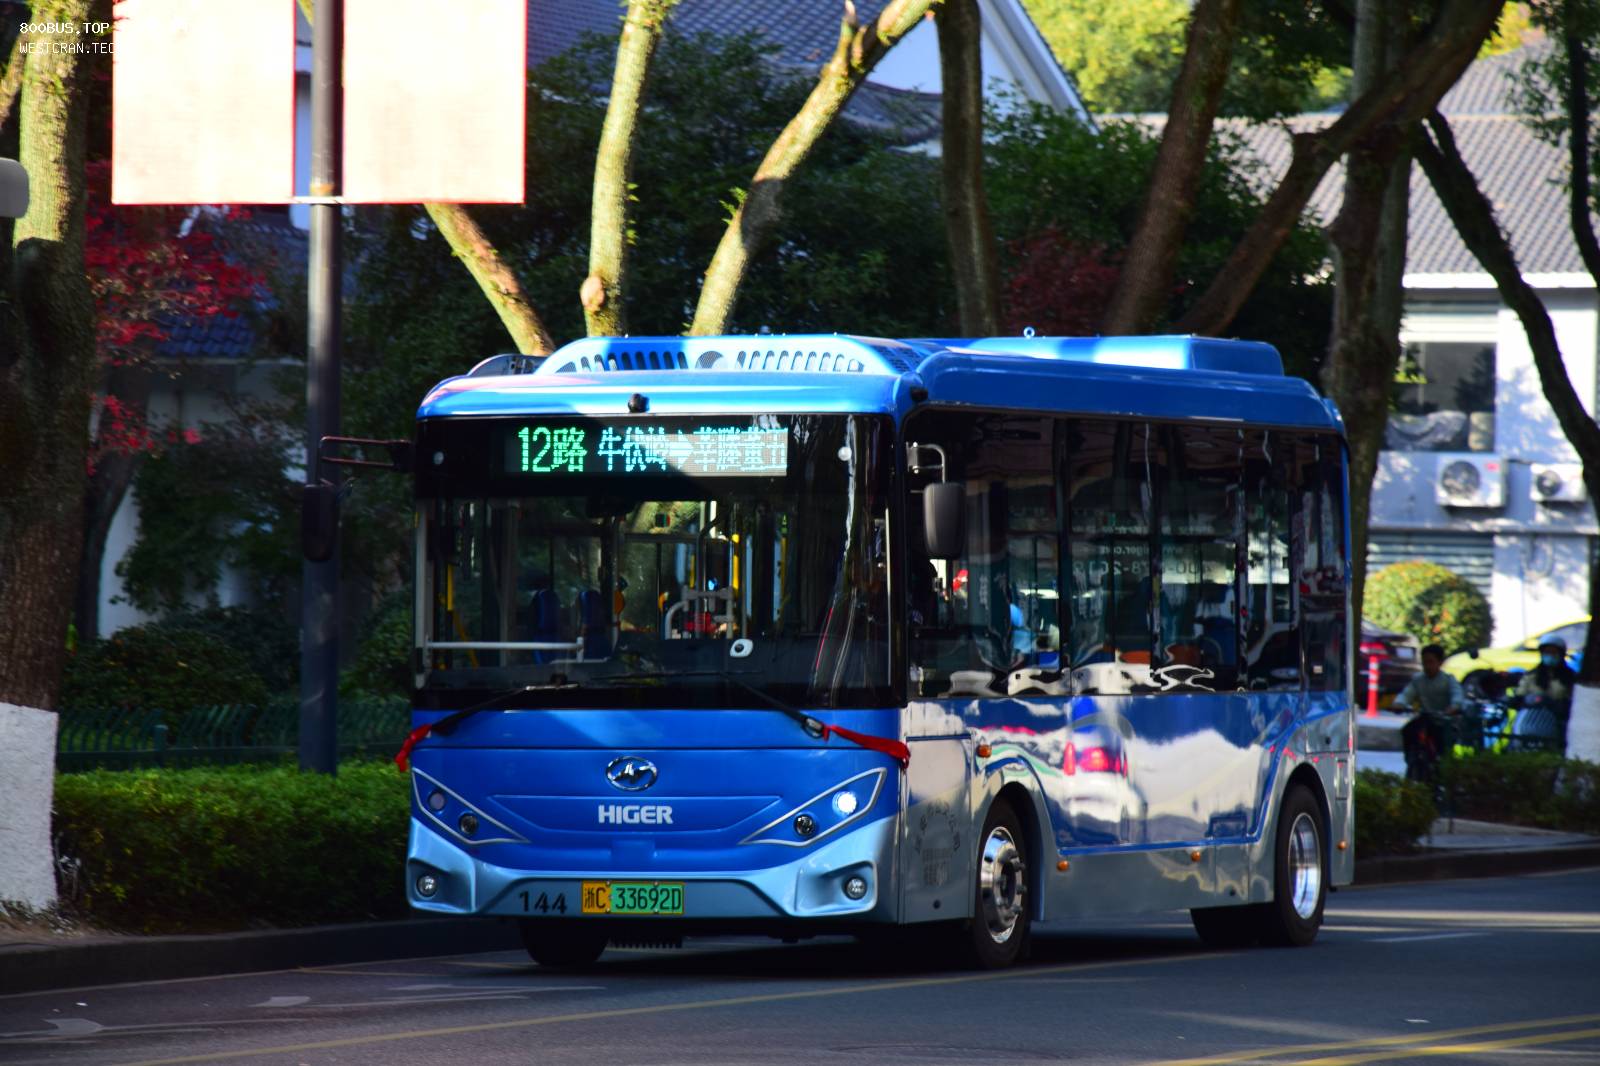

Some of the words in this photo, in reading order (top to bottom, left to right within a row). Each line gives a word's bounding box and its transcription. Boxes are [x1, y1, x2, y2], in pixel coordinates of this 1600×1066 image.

[518, 427, 587, 472] 12路
[598, 804, 674, 825] HIGER
[519, 890, 568, 914] 144
